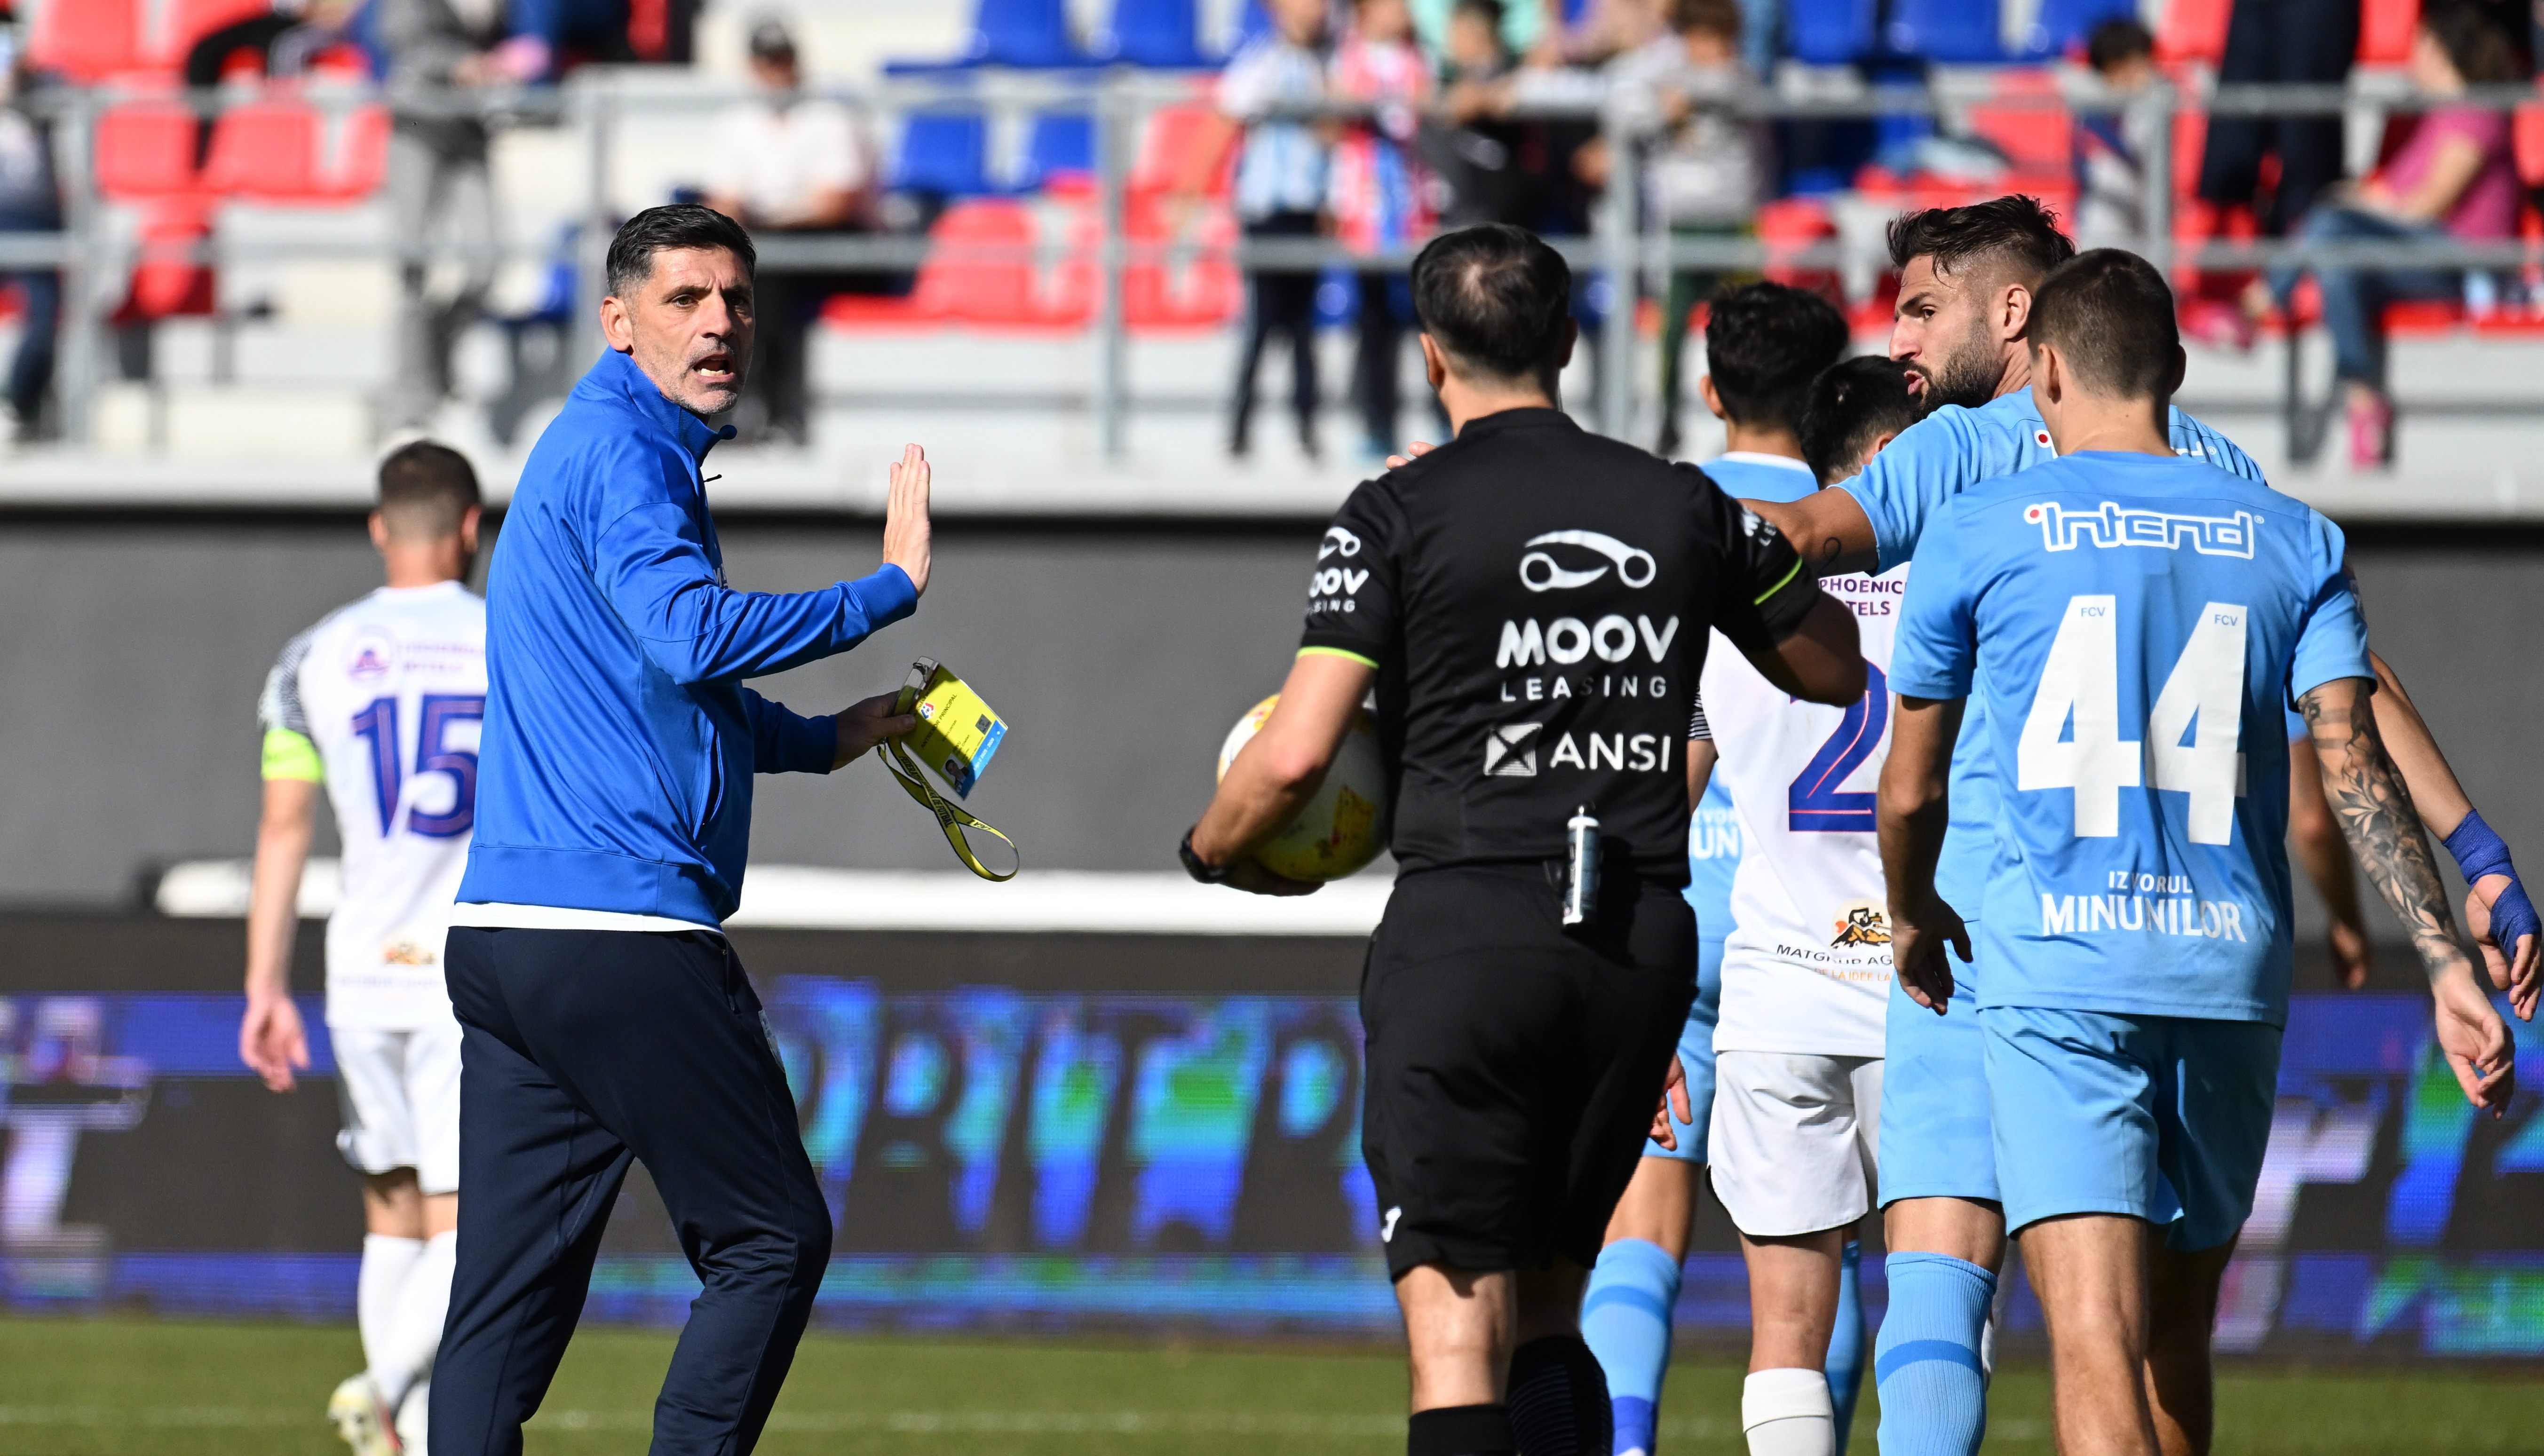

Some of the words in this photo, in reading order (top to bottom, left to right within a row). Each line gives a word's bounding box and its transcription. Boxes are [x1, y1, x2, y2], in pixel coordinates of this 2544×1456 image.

[1819, 578, 1907, 594] PHOENIC
[1845, 600, 1891, 616] TELS
[2081, 607, 2106, 617] FCV
[2214, 614, 2238, 626] FCV
[1496, 614, 1680, 669] MOOV
[1500, 675, 1667, 703] LEASING
[938, 693, 957, 720] PRINCIPAL
[2017, 594, 2247, 846] 44
[1550, 730, 1671, 773] ANSI
[353, 694, 487, 839] 15
[2108, 870, 2193, 894] IZVORUL
[2041, 893, 2247, 943] MINUNILOR
[1867, 955, 1893, 965] AG
